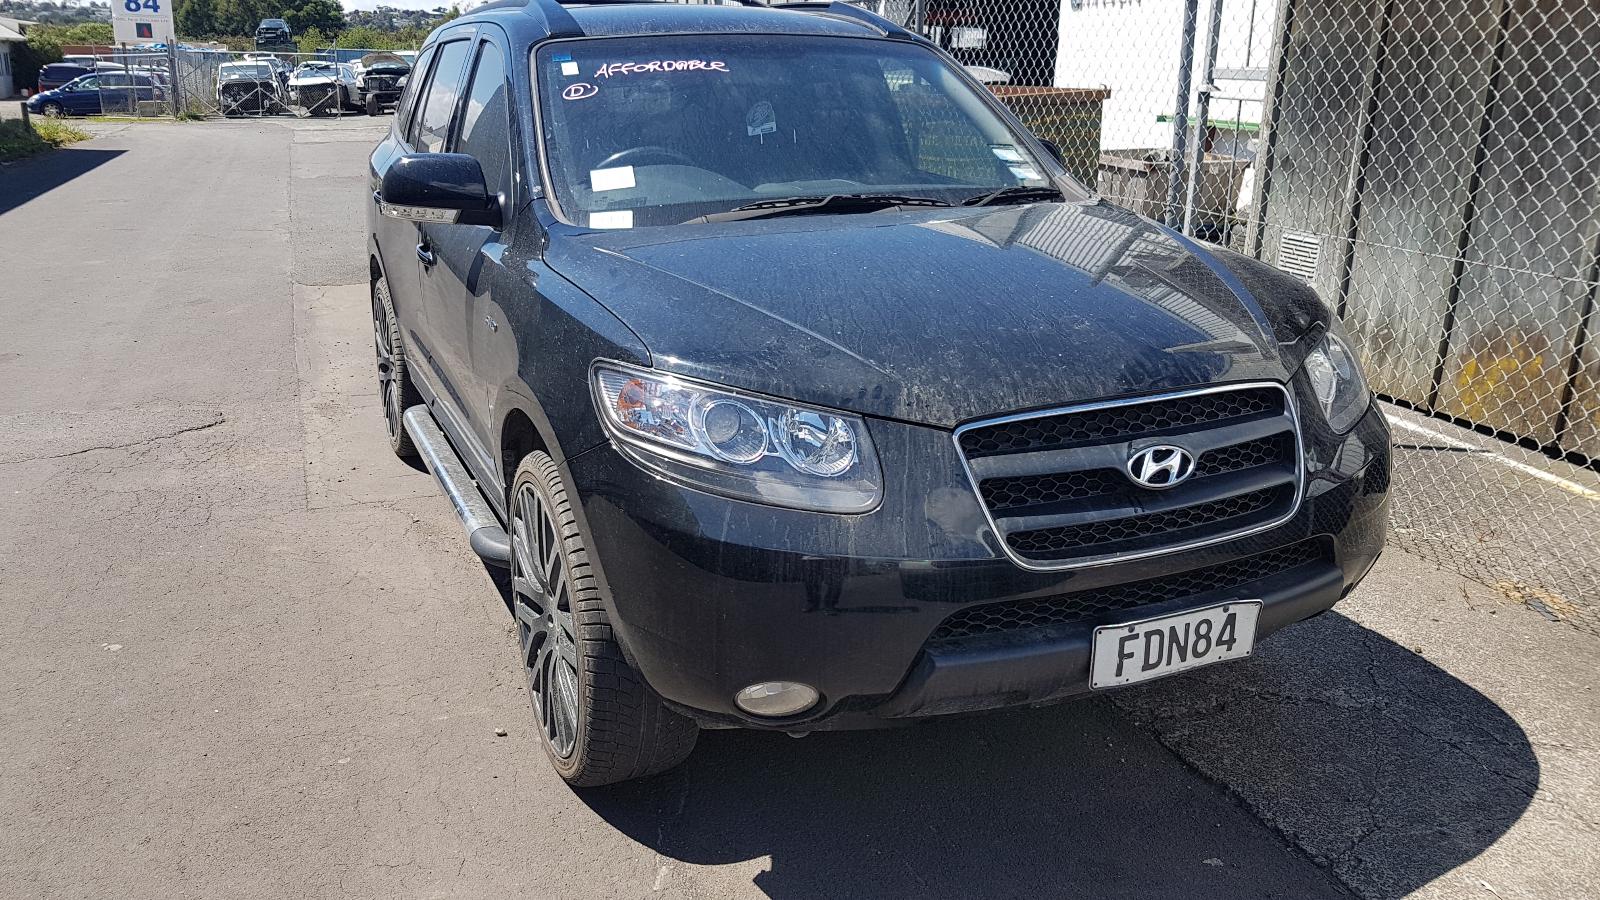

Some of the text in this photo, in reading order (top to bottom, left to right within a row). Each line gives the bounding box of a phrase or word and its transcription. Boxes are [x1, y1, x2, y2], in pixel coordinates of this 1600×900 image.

[125, 0, 160, 12] 84
[570, 86, 584, 97] D
[1115, 612, 1237, 677] FDN84
